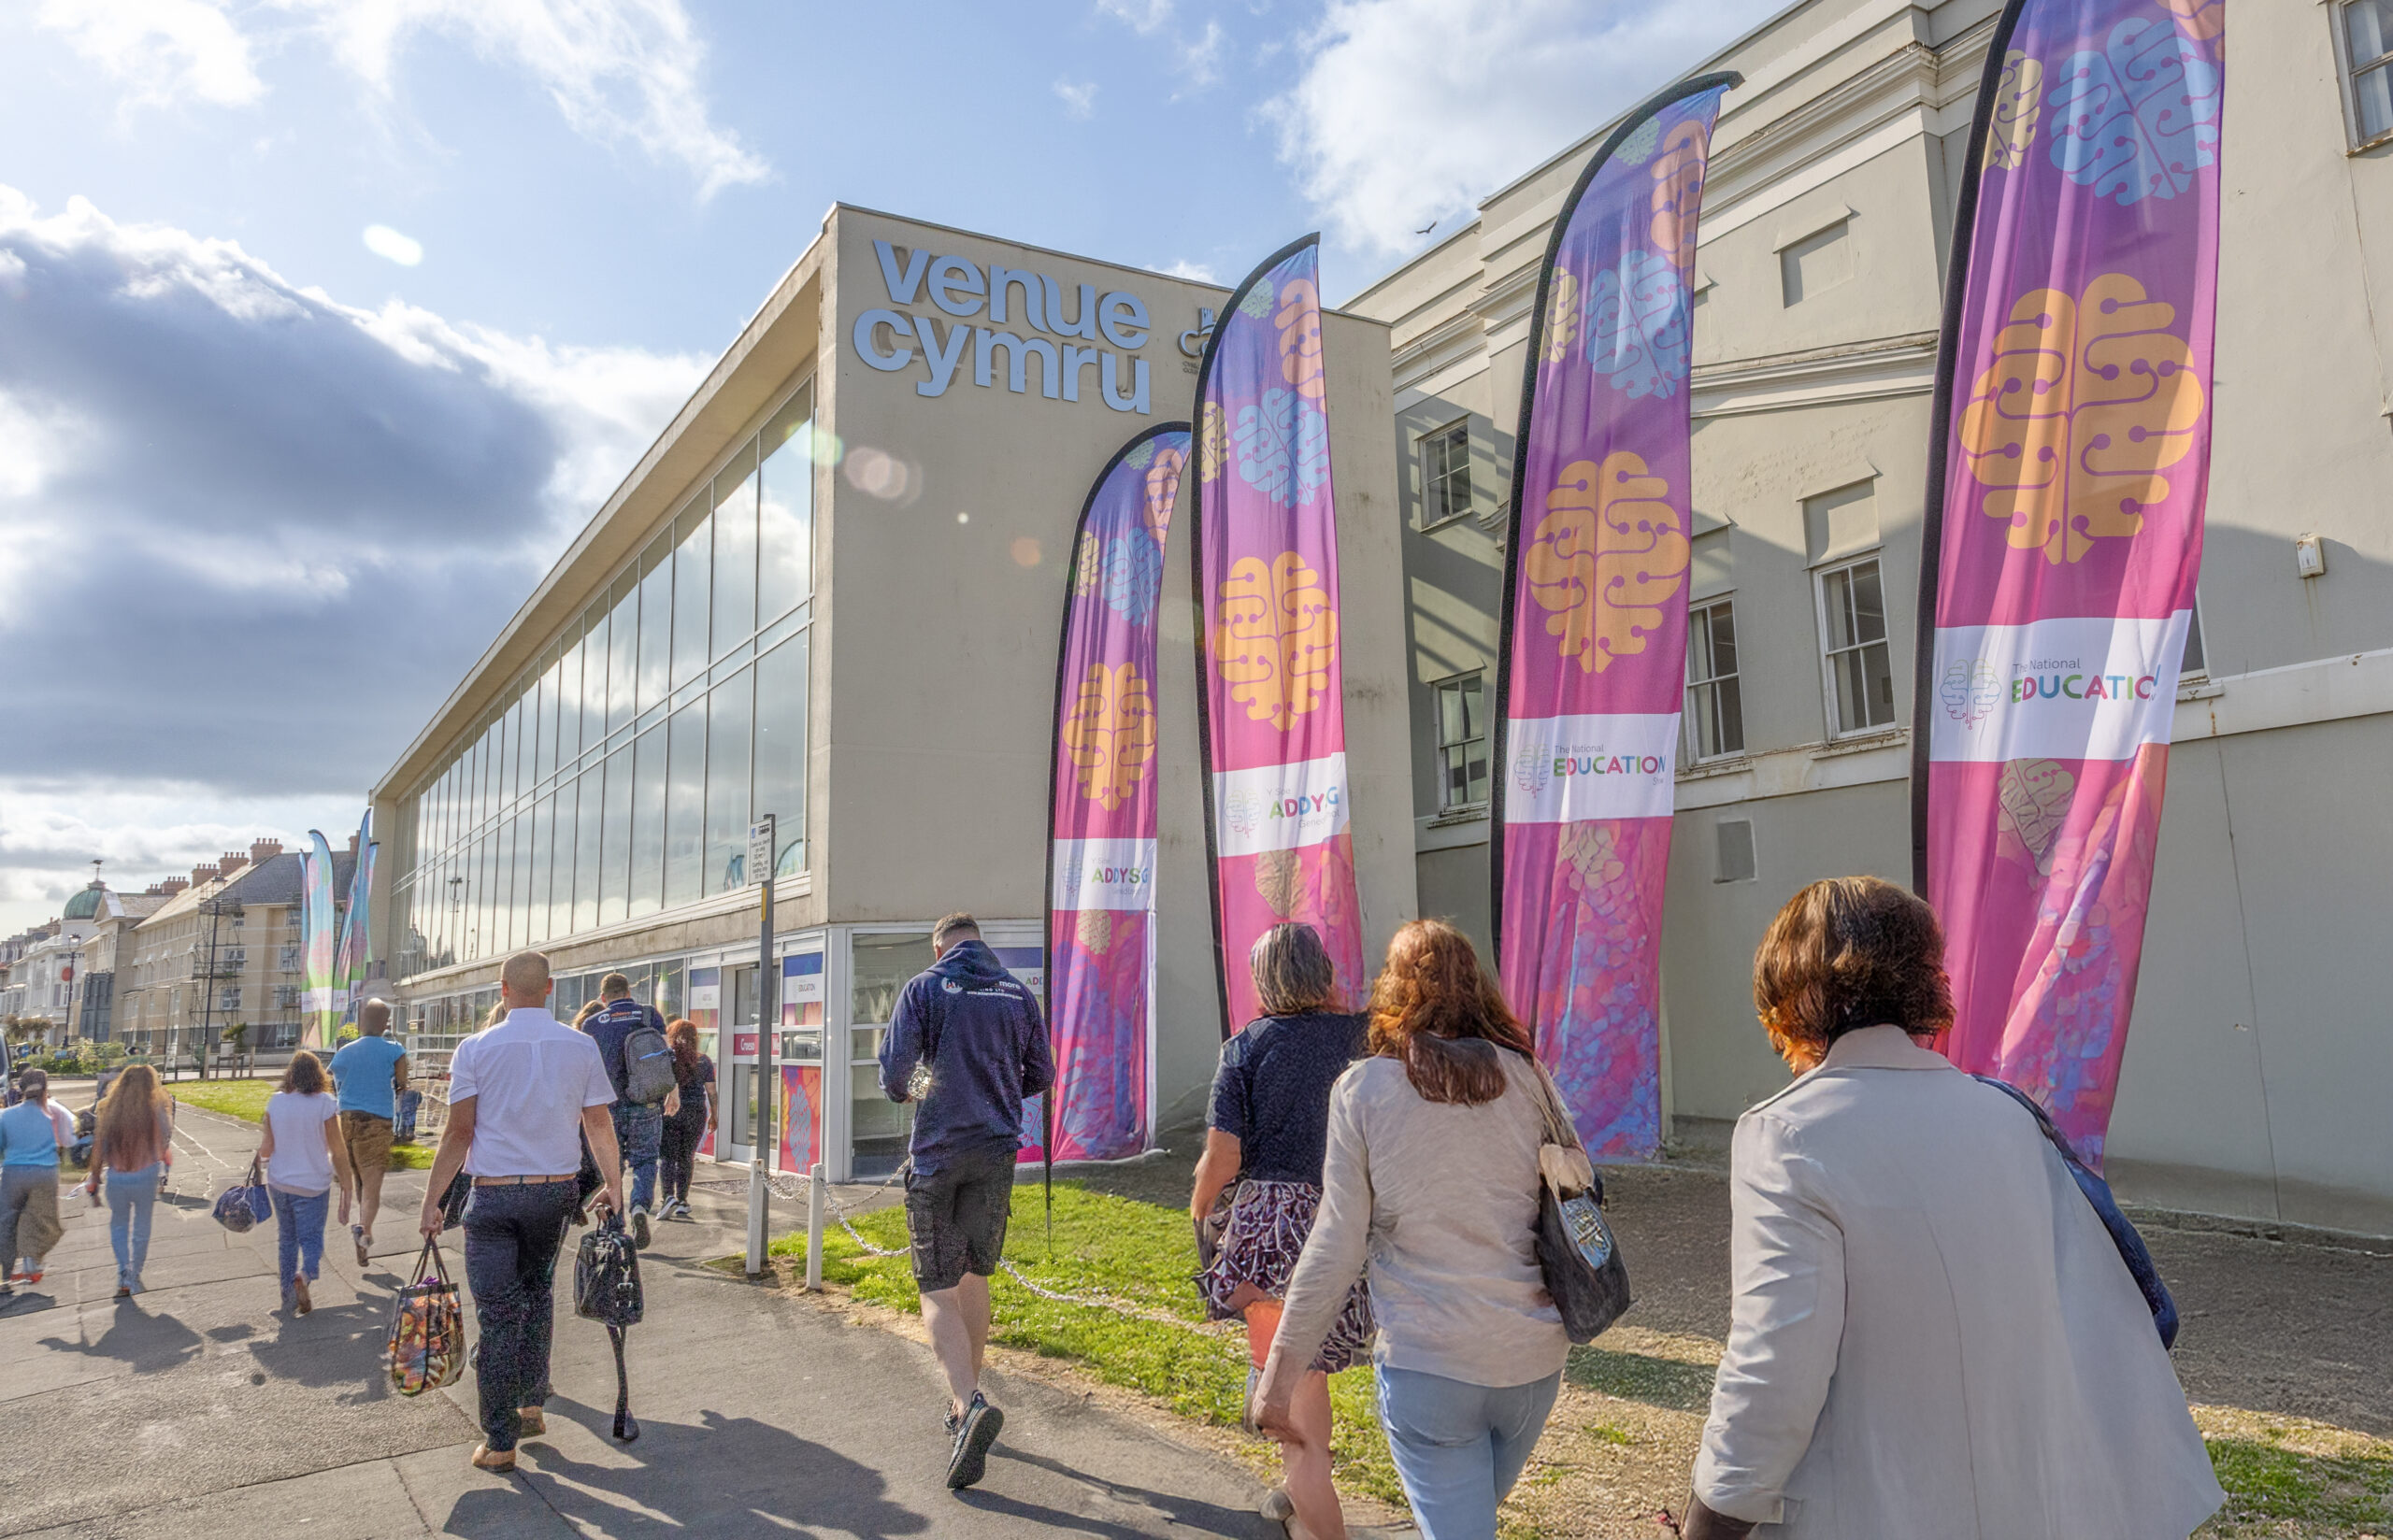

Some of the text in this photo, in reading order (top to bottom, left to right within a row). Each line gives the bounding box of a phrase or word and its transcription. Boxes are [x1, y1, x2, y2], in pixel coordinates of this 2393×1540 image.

[873, 239, 1151, 349] venue
[853, 308, 1151, 415] cymru
[2029, 658, 2081, 670] National
[2012, 664, 2161, 703] EDUCATIO
[1555, 745, 1569, 753] The
[1554, 755, 1667, 777] EDUCATION
[1269, 787, 1340, 820] ADDYG
[1092, 867, 1149, 884] ADDYSG
